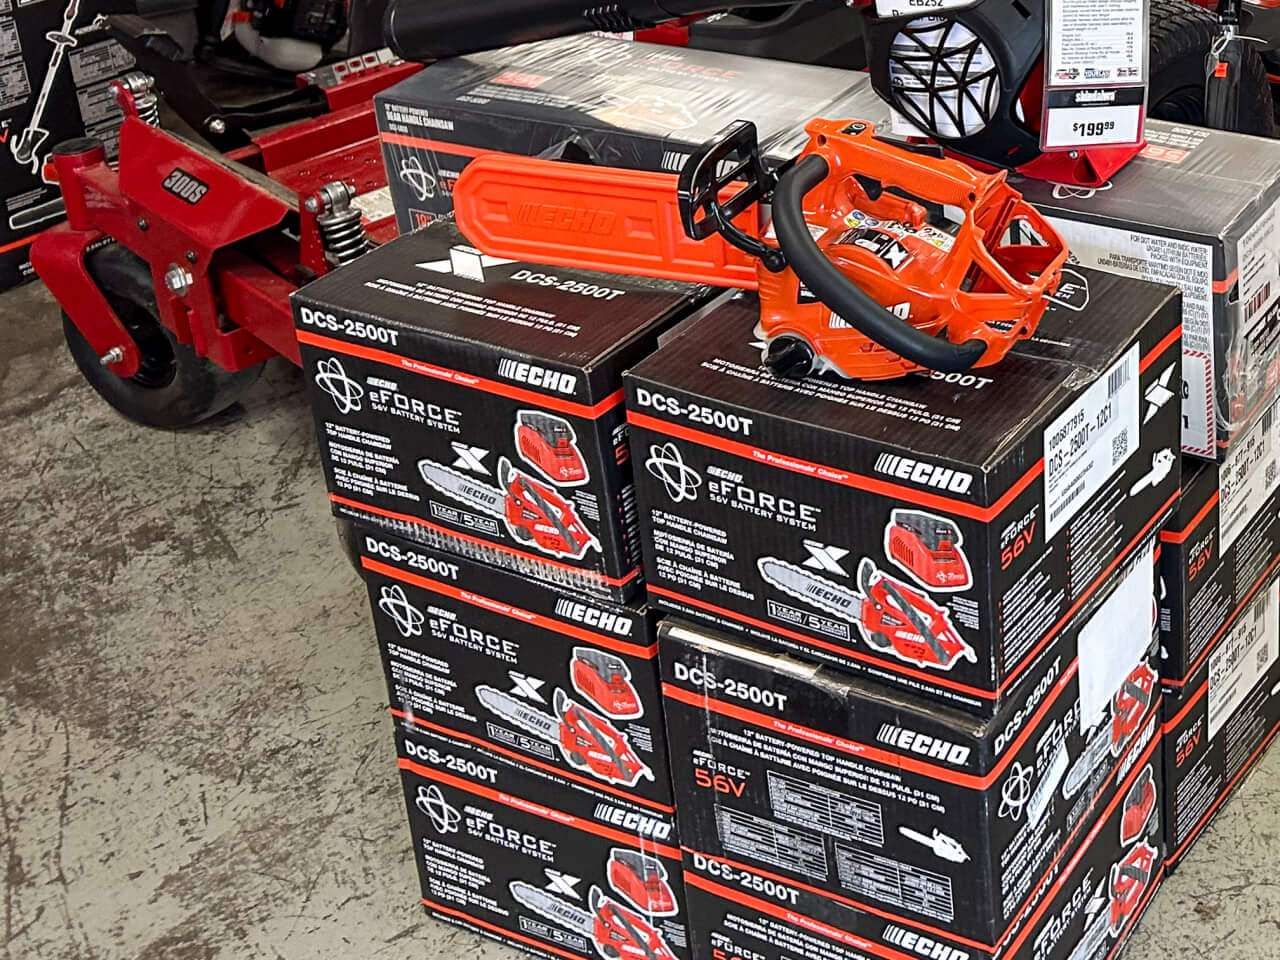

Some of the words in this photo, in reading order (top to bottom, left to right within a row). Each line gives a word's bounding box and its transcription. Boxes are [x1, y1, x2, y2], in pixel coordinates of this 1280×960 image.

[511, 270, 625, 302] DCS-2500T
[300, 307, 399, 346] DCS-2500T
[504, 359, 577, 396] ECHO
[390, 406, 425, 424] BATTERY
[427, 416, 461, 435] SYSTEM
[636, 388, 753, 436] DCS-2500T
[706, 466, 744, 484] ECHO
[884, 452, 973, 496] ECHO
[708, 481, 820, 523] eFORCE
[709, 493, 729, 507] 56V
[731, 498, 774, 520] BATTERY
[776, 510, 817, 532] SYSTEM
[366, 539, 459, 580] DCS-2500T
[1001, 522, 1036, 570] 56V
[1188, 535, 1215, 582] 56V
[811, 583, 852, 608] ECHO
[562, 599, 632, 637] ECHO
[449, 633, 483, 654] BATTERY
[485, 645, 517, 665] SYSTEM
[674, 662, 787, 712] DCS-2500T
[994, 656, 1062, 756] DCS-2500T
[404, 740, 499, 783] DCS-2500T
[887, 726, 971, 766] ECHO
[1121, 715, 1156, 782] ECHO
[695, 768, 746, 798] 56V
[600, 805, 671, 841] ECHO
[486, 831, 519, 852] BATTERY
[522, 843, 554, 864] SYSTEM
[693, 852, 799, 906] DCS-2500T
